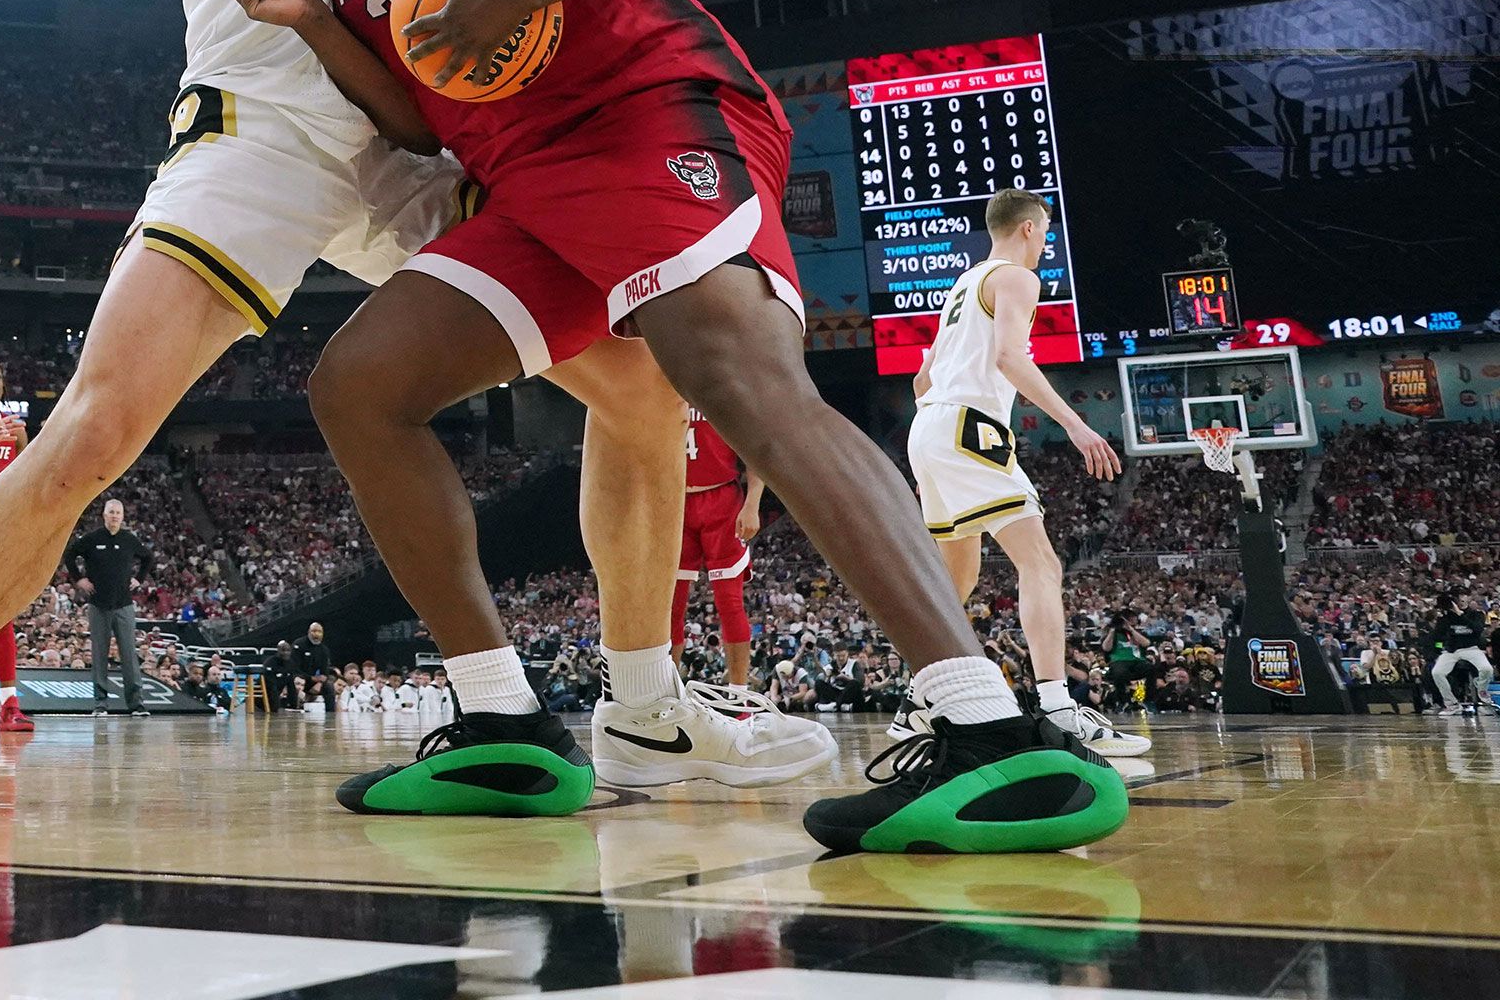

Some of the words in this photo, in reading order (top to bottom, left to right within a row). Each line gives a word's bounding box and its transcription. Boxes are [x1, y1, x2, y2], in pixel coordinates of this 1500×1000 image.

[888, 86, 907, 96] PTS
[915, 82, 934, 93] REB
[941, 79, 961, 90] AST
[969, 76, 987, 87] STL
[995, 72, 1015, 83] BLK
[1024, 68, 1042, 80] FLS
[860, 109, 873, 123] 0
[891, 104, 911, 120] 13
[922, 101, 933, 116] 2
[948, 98, 960, 113] 0
[976, 95, 985, 110] 1
[1003, 91, 1015, 106] 0
[1031, 88, 1043, 102] 0
[1303, 89, 1411, 134] FINAL
[863, 129, 873, 144] 1
[898, 125, 909, 140] 5
[924, 122, 936, 137] 2
[951, 118, 963, 133] 0
[979, 115, 988, 130] 1
[1005, 112, 1018, 127] 0
[1033, 108, 1046, 123] 0
[860, 148, 882, 165] 14
[899, 145, 911, 160] 0
[926, 142, 938, 157] 2
[953, 139, 965, 154] 0
[981, 136, 991, 151] 1
[1008, 133, 1018, 148] 1
[1036, 129, 1048, 145] 2
[1310, 127, 1415, 172] FOUR
[861, 169, 883, 185] 30
[901, 166, 914, 181] 4
[928, 163, 941, 178] 0
[955, 160, 968, 175] 4
[983, 157, 995, 172] 0
[1010, 153, 1023, 169] 0
[1039, 151, 1051, 166] 3
[863, 189, 887, 206] 34
[903, 186, 916, 202] 0
[930, 183, 943, 199] 2
[958, 181, 970, 196] 2
[986, 178, 996, 193] 1
[1013, 175, 1026, 190] 0
[1041, 172, 1054, 187] 2
[884, 210, 913, 222] FIELD
[913, 207, 944, 219] GOAL
[874, 221, 918, 240] 13/31
[921, 216, 971, 238] (42%)
[883, 245, 917, 257] THREE
[917, 241, 952, 254] POINT
[882, 257, 919, 275] 3/10
[921, 252, 971, 274] (30%)
[1040, 267, 1065, 280] POT
[625, 268, 661, 307] PACK
[888, 281, 913, 293] FREE
[913, 278, 956, 291] THROW
[1048, 280, 1059, 296] 7
[1178, 276, 1228, 296] 18:01
[894, 292, 924, 309] 0/0
[946, 287, 968, 328] 2
[1193, 296, 1227, 326] 14
[1430, 311, 1458, 322] 2ND
[1085, 332, 1107, 342] TOL
[1119, 329, 1139, 339] FLS
[1256, 323, 1291, 344] 29
[1328, 314, 1405, 339] 18:01
[1428, 320, 1462, 331] HALF
[1090, 342, 1104, 357] 3
[1123, 339, 1137, 355] 3
[1388, 369, 1427, 384] FINAL
[1390, 382, 1427, 397] FOUR
[1258, 650, 1289, 662] FINAL
[1259, 661, 1290, 674] FOUR
[20, 679, 120, 699] PURDU
